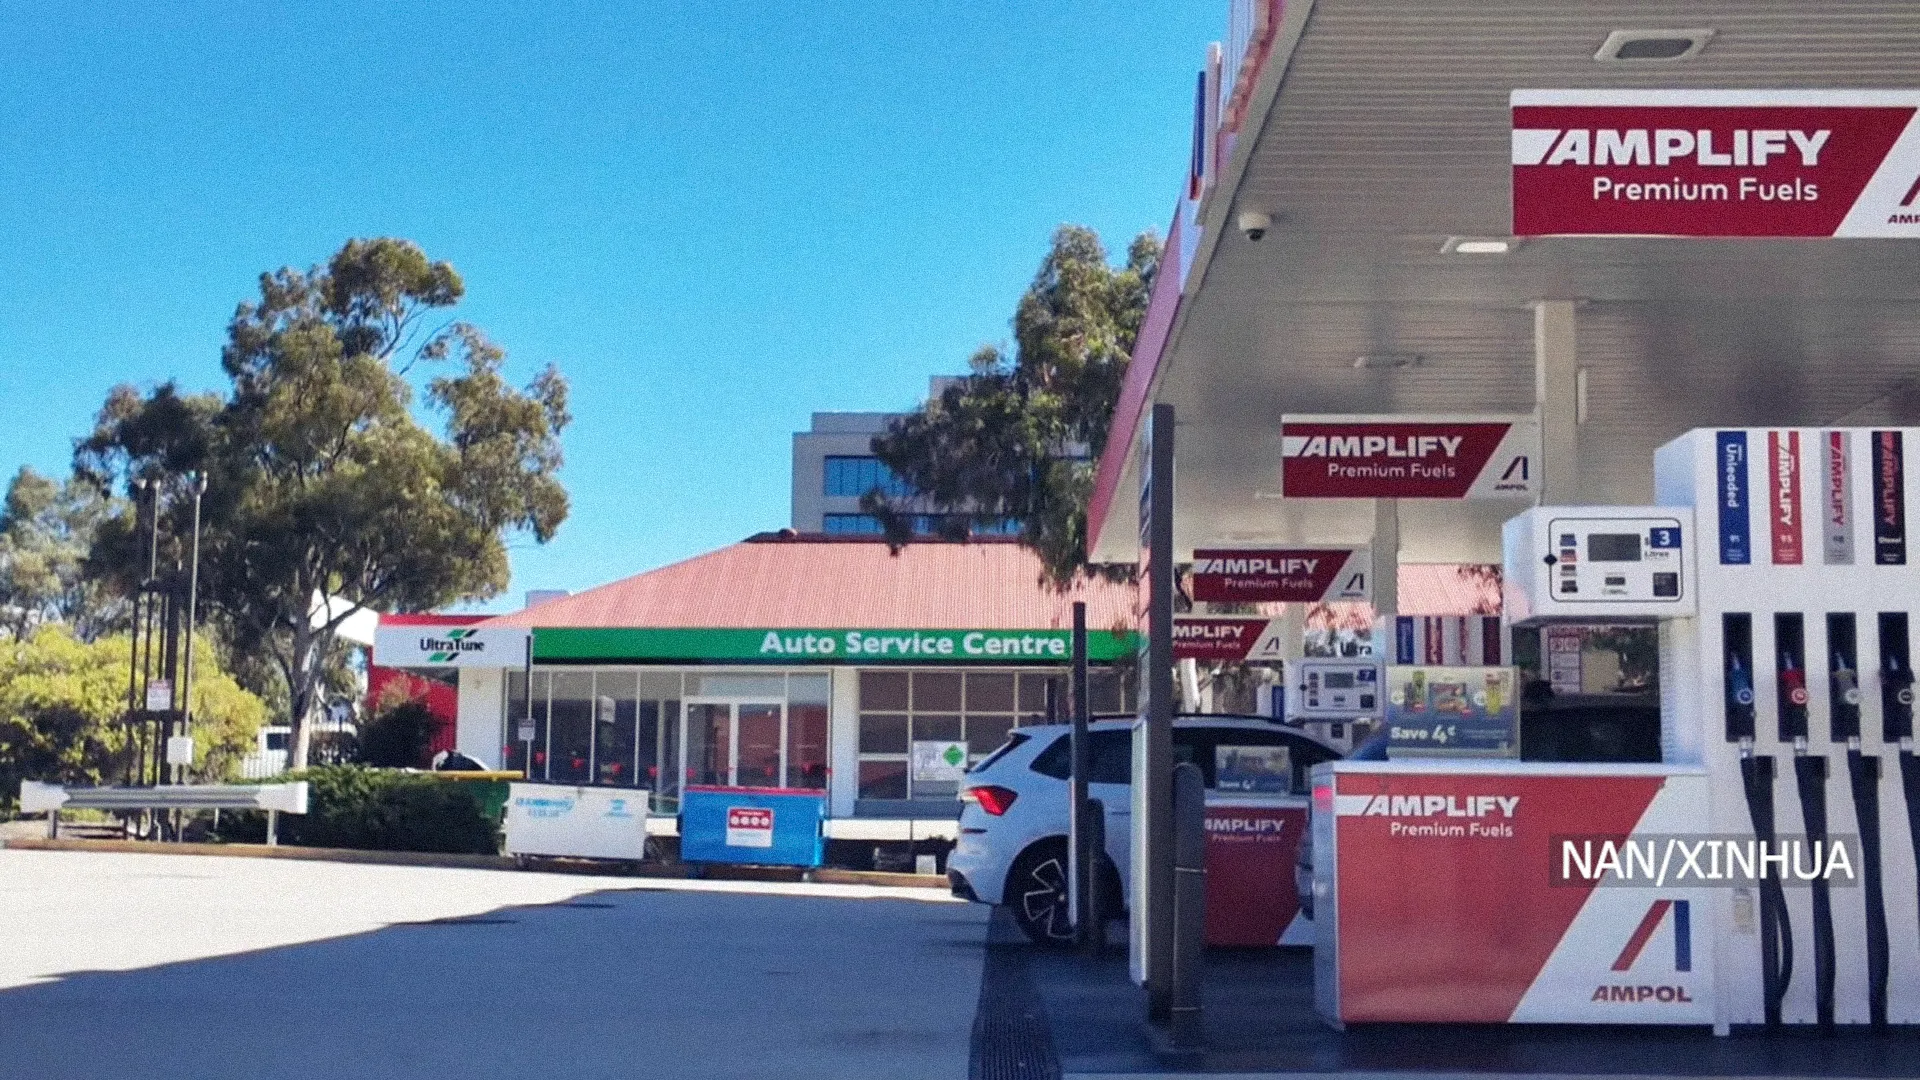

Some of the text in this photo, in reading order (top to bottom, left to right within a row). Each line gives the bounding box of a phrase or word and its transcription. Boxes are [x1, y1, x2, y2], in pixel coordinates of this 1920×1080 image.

[1545, 128, 1831, 166] AMPLIFY
[1593, 176, 1819, 201] Premium Fuels
[1301, 436, 1462, 458] AMPLIFY
[1328, 463, 1456, 478] Premium Fuels
[1726, 443, 1740, 508] Unleaded
[1778, 447, 1793, 526] AMPLIFY
[1830, 448, 1844, 526] AMPLIFY
[1881, 448, 1896, 526] AMPLIFY
[1658, 530, 1671, 546] 3
[1207, 559, 1319, 574] AMPLIFY
[1225, 578, 1313, 588] Premium Fuels
[1172, 625, 1244, 638] MPLIFY
[760, 631, 1065, 655] Auto Service Centre
[1390, 726, 1429, 739] Save
[1367, 795, 1520, 818] AMPLIFY
[1390, 822, 1514, 838] Premium Fuels
[1592, 985, 1692, 1003] AMPOL
